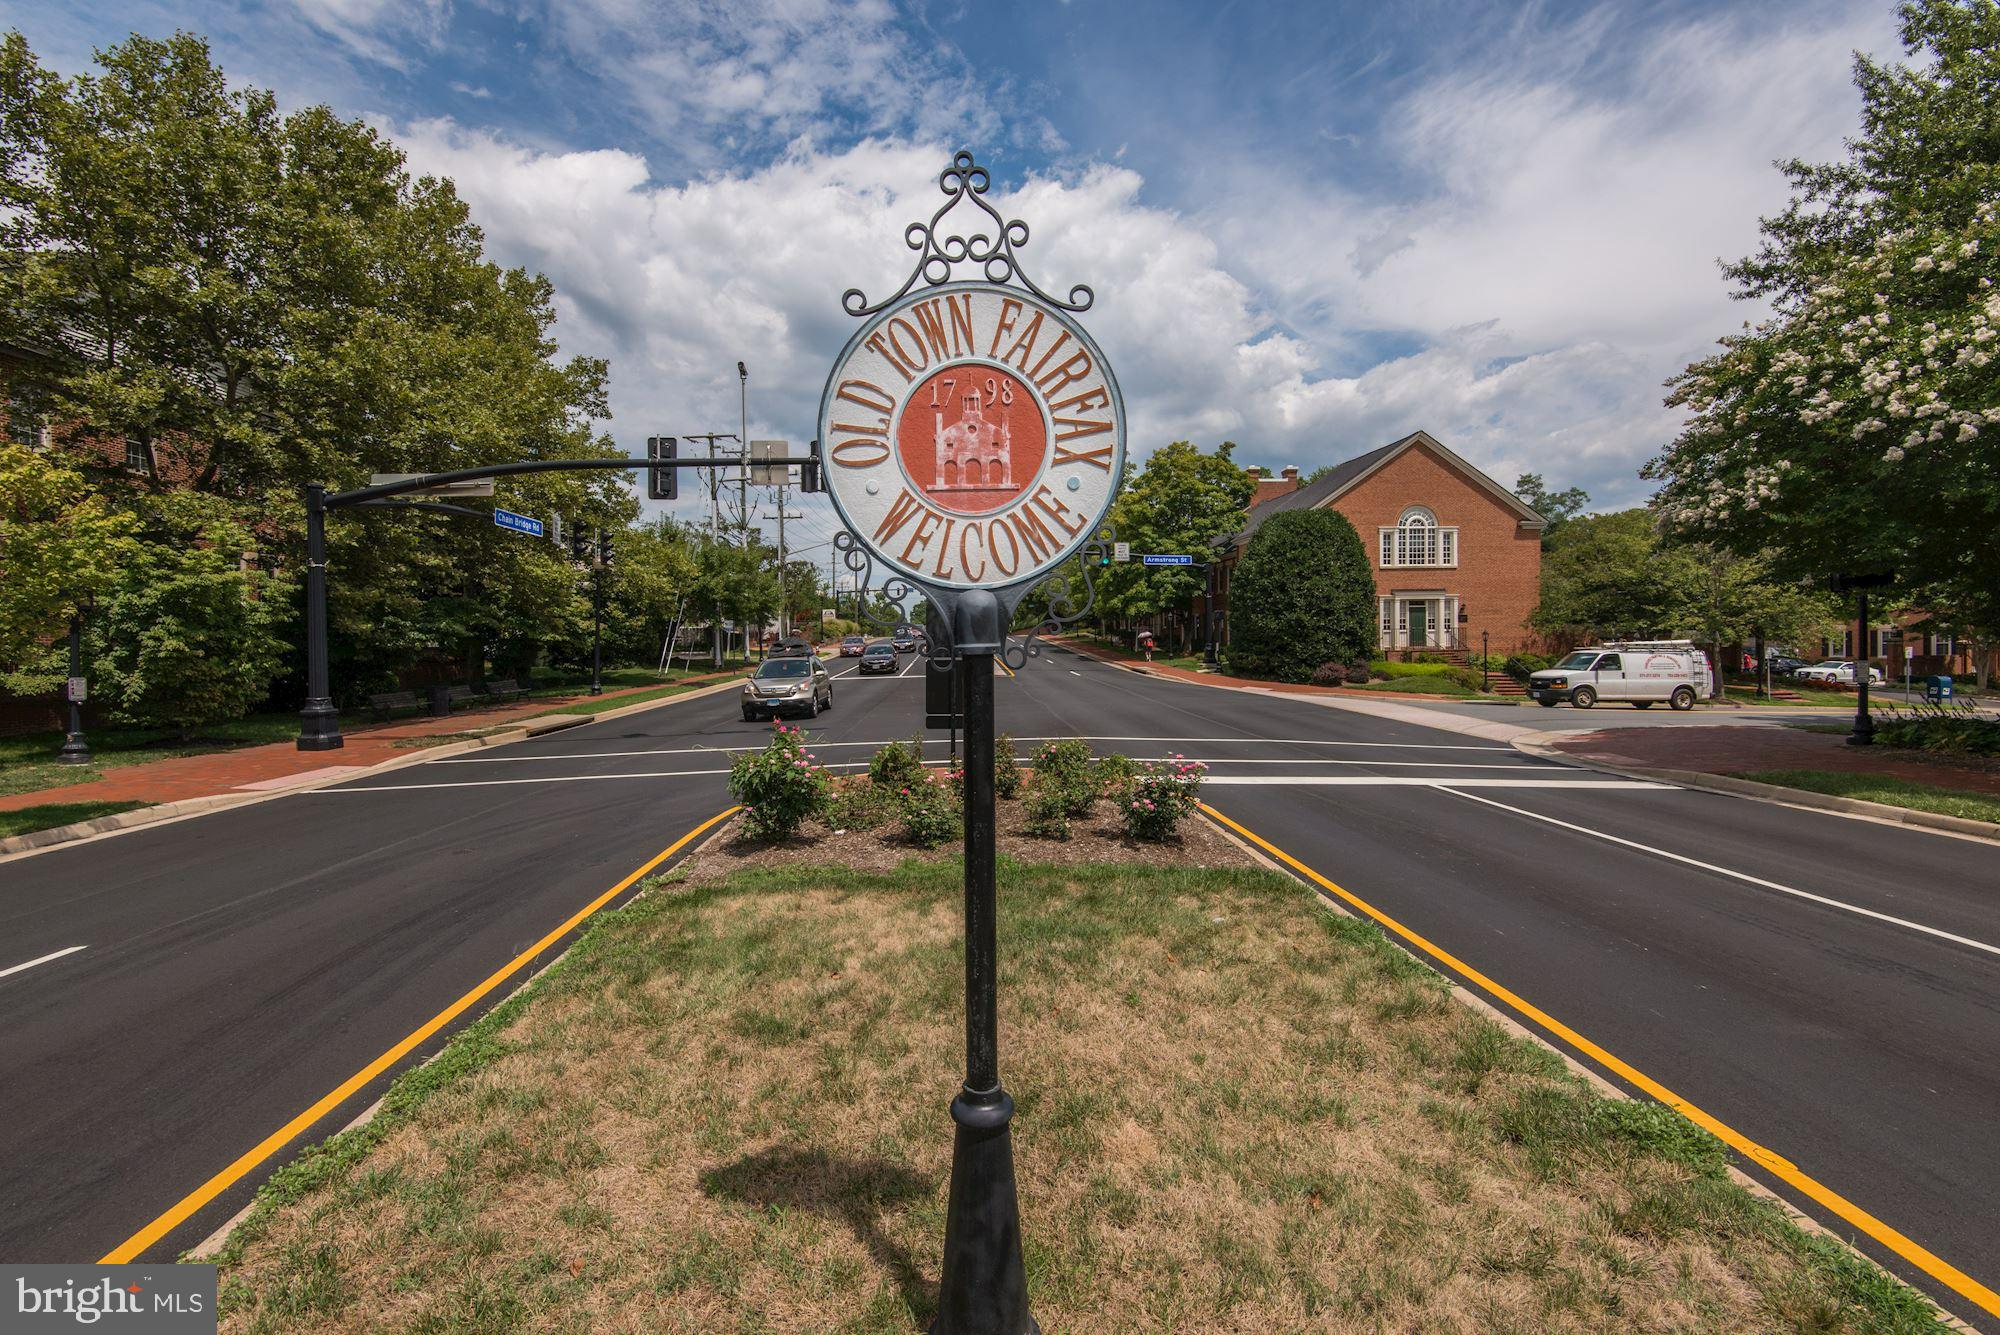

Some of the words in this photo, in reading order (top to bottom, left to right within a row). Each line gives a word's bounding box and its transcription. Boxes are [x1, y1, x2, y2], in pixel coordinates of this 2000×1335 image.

[831, 379, 897, 467] OLD
[865, 293, 975, 383] TOWN
[987, 298, 1114, 473] FAIRFAX
[498, 512, 514, 524] Chain
[515, 517, 532, 531] Bridge
[533, 522, 540, 532] Rd
[873, 483, 1088, 583] WELCOME
[1146, 556, 1179, 564] Armstrong
